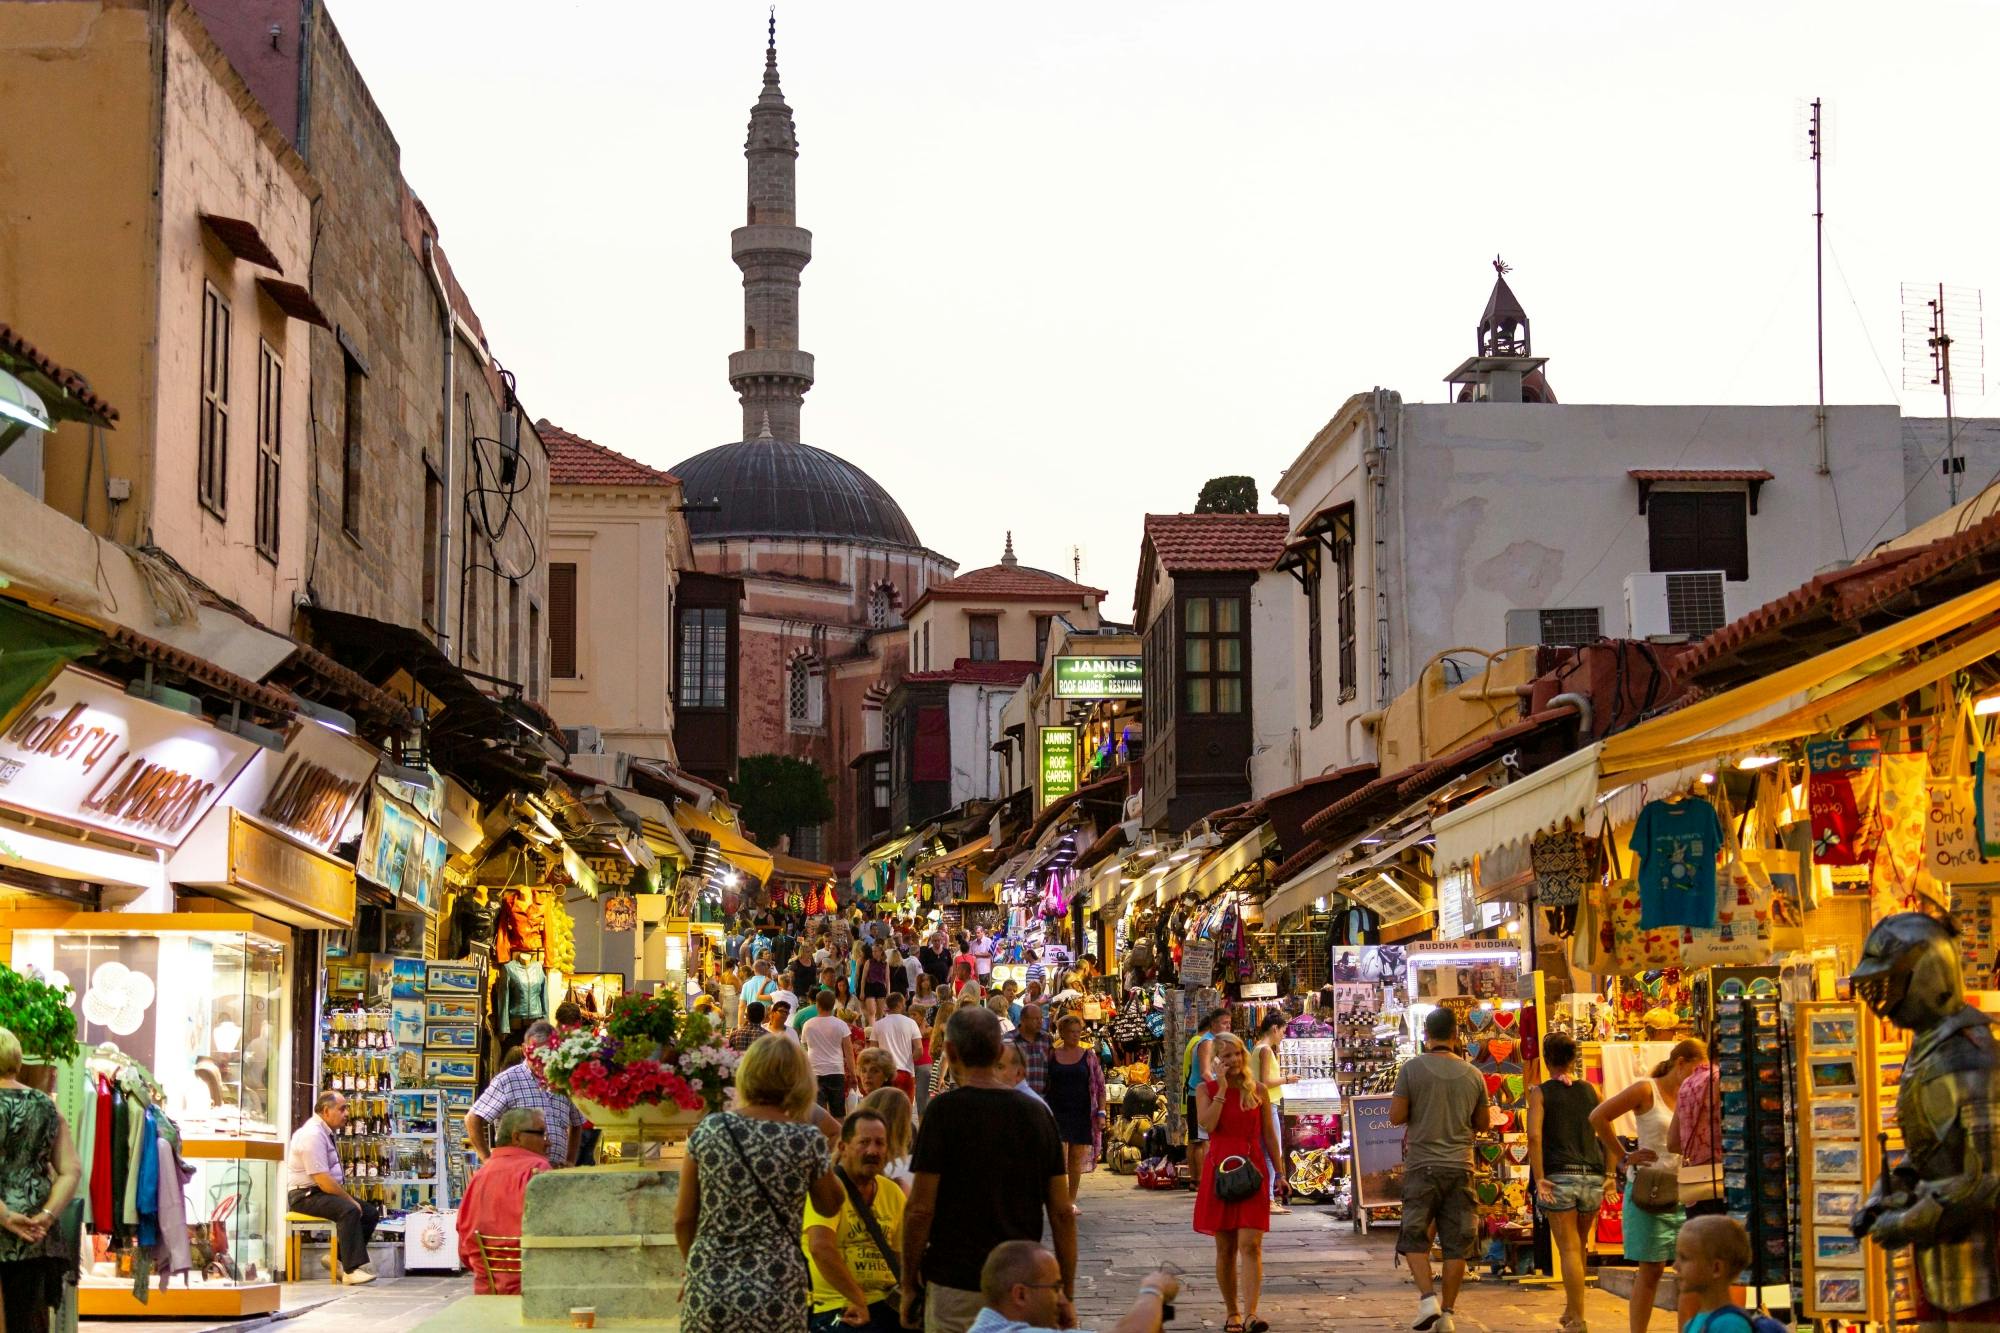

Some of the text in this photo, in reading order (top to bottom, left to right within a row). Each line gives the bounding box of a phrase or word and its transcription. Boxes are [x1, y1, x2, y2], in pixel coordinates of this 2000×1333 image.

[1070, 660, 1138, 673] JANNIS
[1060, 680, 1077, 694] ROOF
[1078, 680, 1104, 694] GARDEN
[9, 691, 119, 775] Gallery
[1045, 732, 1072, 745] JANNIS
[1049, 756, 1068, 769] ROOF
[1045, 770, 1072, 783] GARDEN
[80, 749, 216, 833] LAMBROS
[1419, 942, 1459, 950] BUDDHA
[1474, 941, 1514, 949] BUDDHA
[1369, 1120, 1400, 1130] GAR
